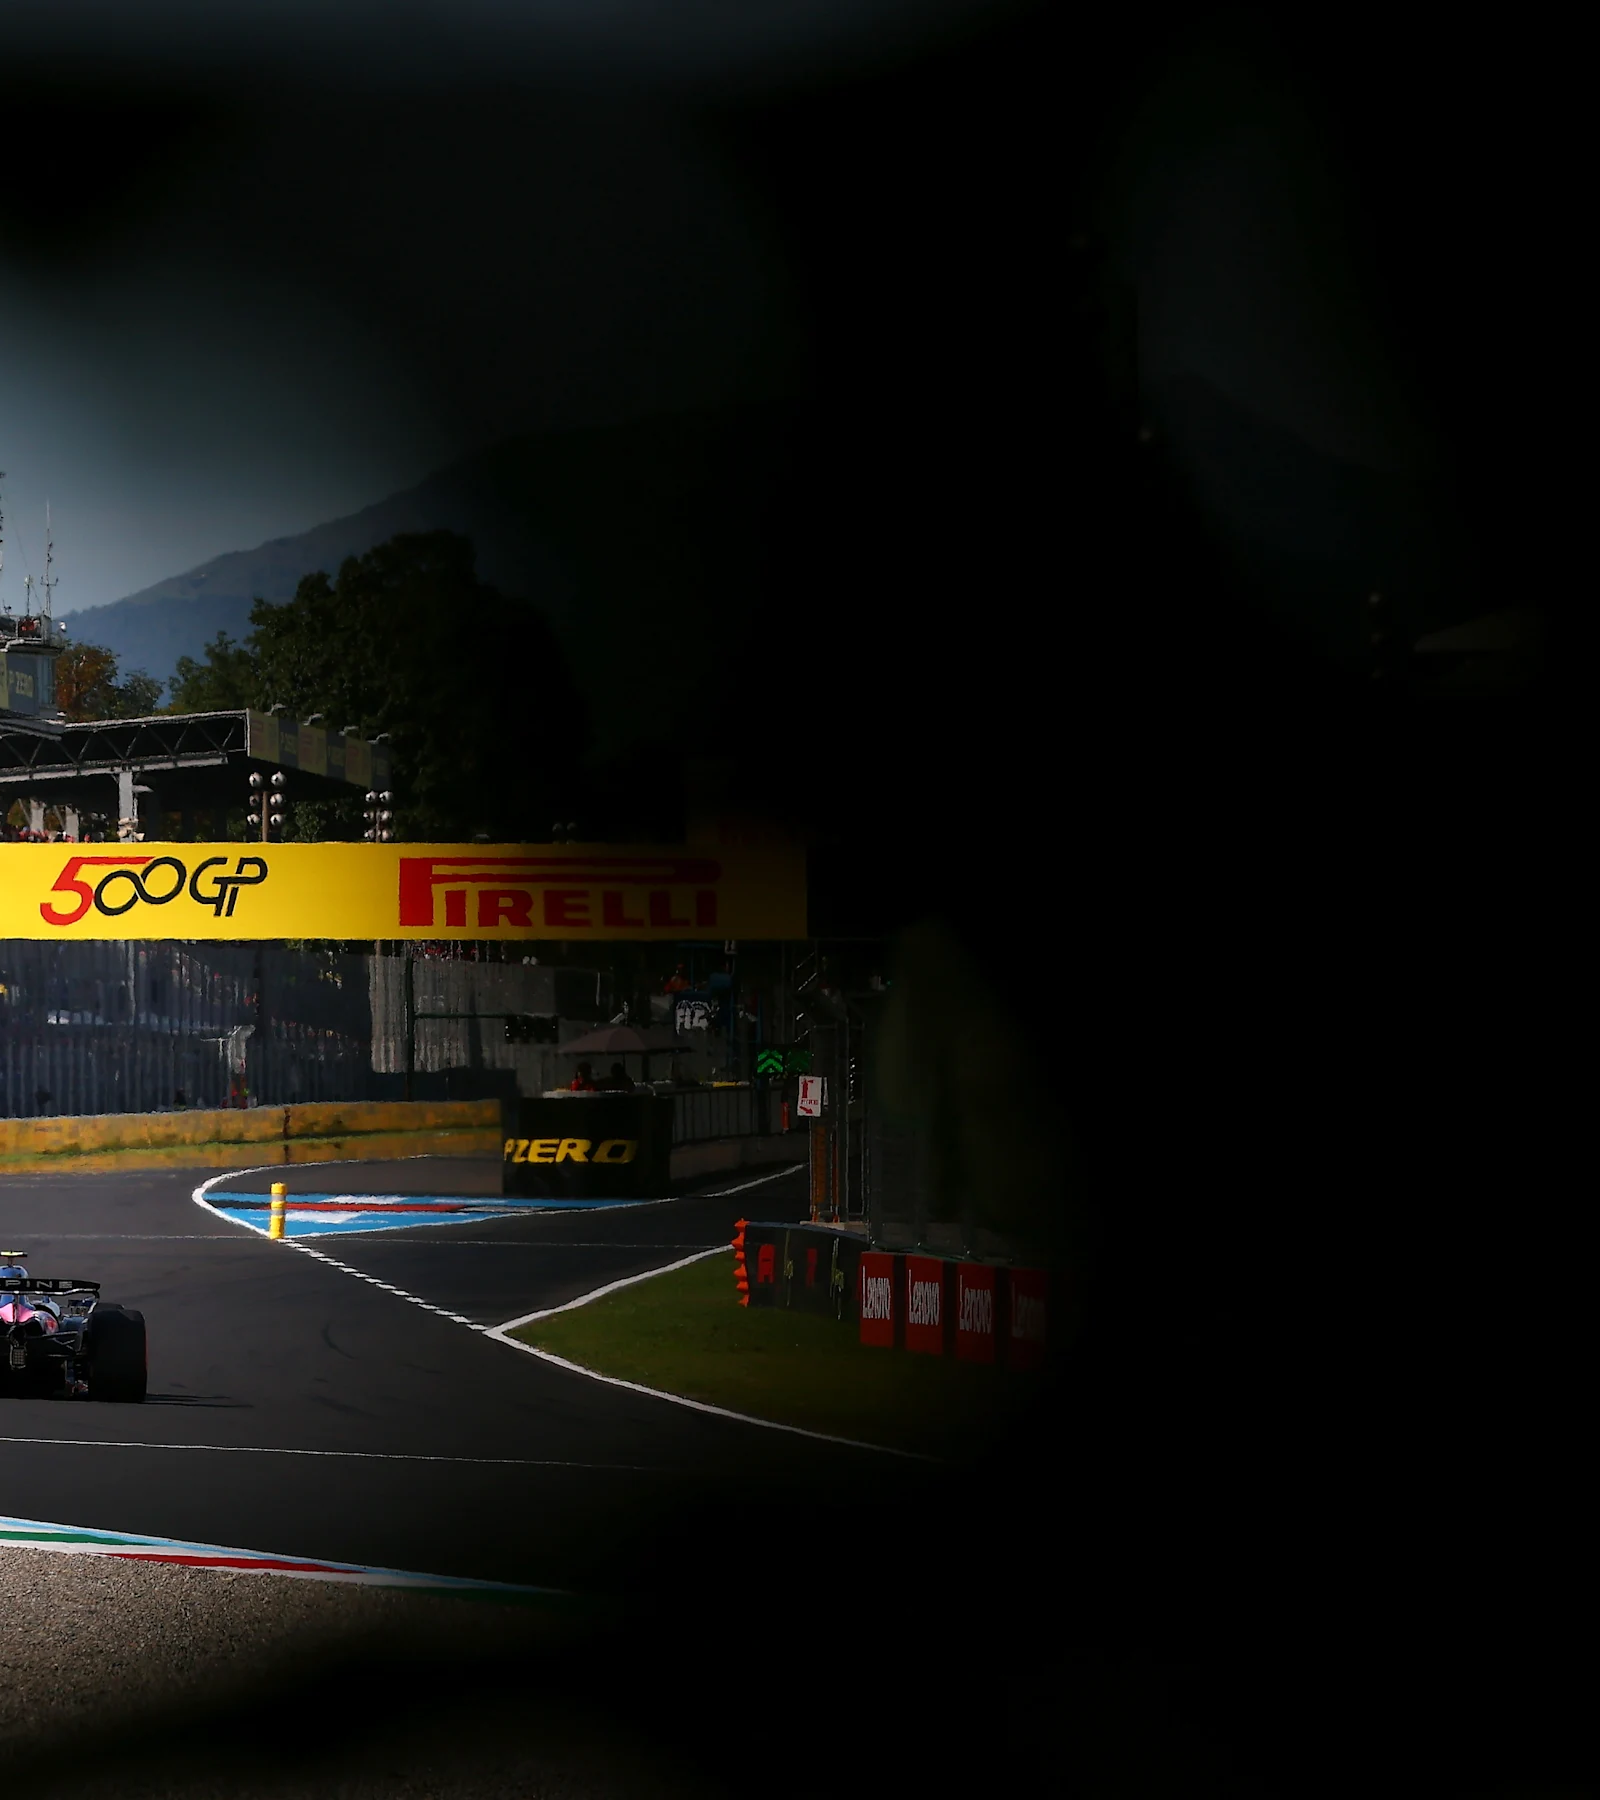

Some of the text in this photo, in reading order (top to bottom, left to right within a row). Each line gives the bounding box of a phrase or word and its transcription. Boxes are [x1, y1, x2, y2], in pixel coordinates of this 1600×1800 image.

[399, 857, 721, 927] PIRELLI
[862, 1264, 891, 1321] Lenovo
[908, 1268, 941, 1327] Lenovo
[959, 1274, 993, 1335] Lenovo
